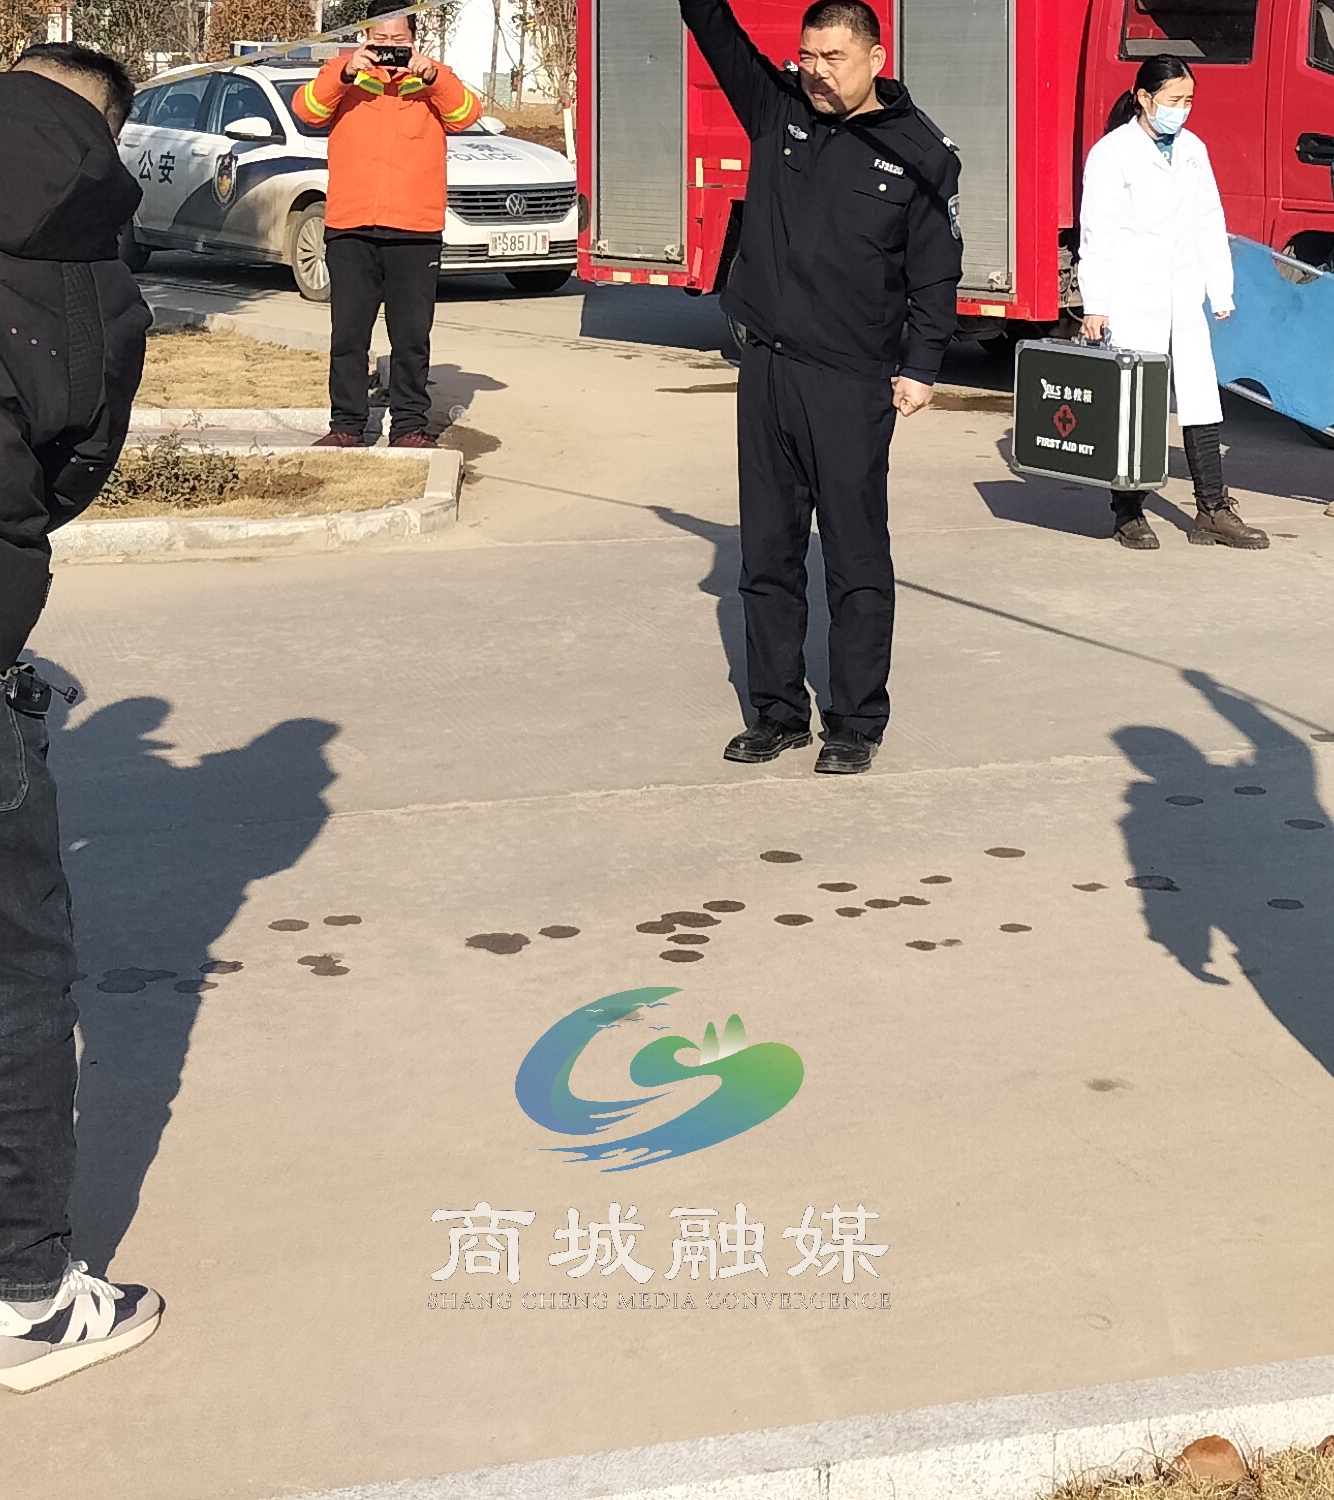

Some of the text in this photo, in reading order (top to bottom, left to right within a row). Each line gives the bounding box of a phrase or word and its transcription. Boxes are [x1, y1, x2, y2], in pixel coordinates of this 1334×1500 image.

[138, 149, 176, 185] 公安
[1036, 436, 1095, 456] FIRST AID KIT
